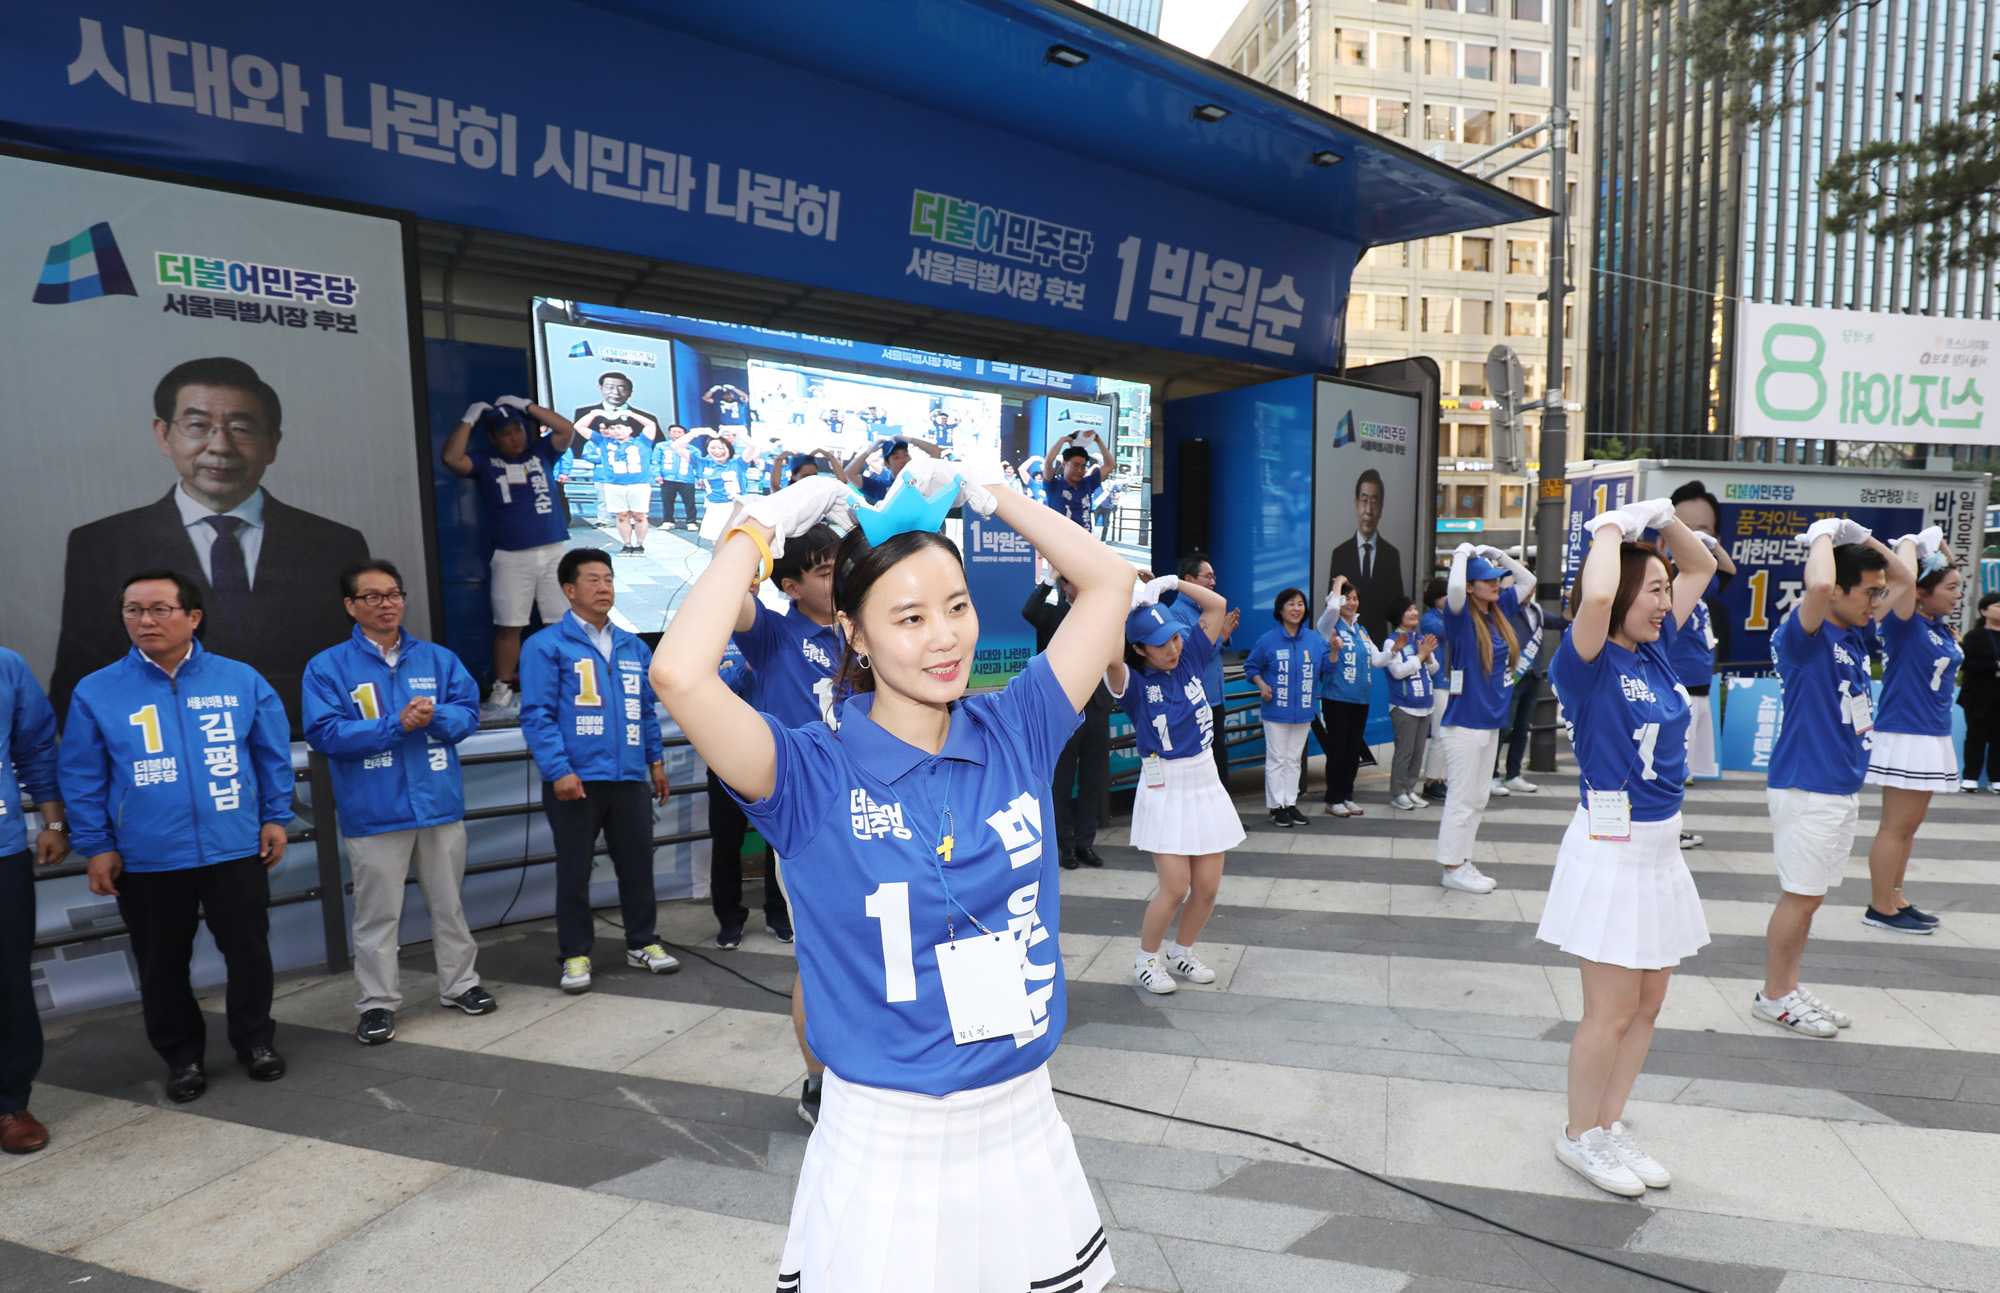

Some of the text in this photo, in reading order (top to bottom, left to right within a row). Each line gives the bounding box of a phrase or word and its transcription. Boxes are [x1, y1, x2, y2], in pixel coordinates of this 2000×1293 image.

[67, 17, 840, 241] 시대와 나란히 시민과 나란히
[909, 188, 1094, 275] 더불어민주당
[155, 251, 359, 307] 더불어민주당
[906, 248, 1086, 310] 서울특별시장 후보
[1113, 235, 1305, 356] 1 박원순
[163, 293, 358, 334] 서울특별시장 후보
[1360, 421, 1407, 443] 더불어민주당
[1725, 483, 1795, 500] 더불어민주당
[1860, 488, 1904, 504] 강남구청장
[970, 521, 1030, 553] 1 박원순
[1737, 509, 1808, 536] 품격있는
[1150, 608, 1164, 625] 1
[1744, 569, 1769, 631] 1
[973, 647, 1030, 661] 시대와 나란히
[973, 661, 1002, 675] 시민과
[1304, 650, 1311, 663] 1
[574, 658, 602, 706] 1
[1277, 660, 1289, 700] 시의원
[1930, 656, 1950, 691] 1
[187, 695, 239, 710] 서울시의원 후보
[350, 682, 381, 720] 1
[813, 677, 838, 731] 1
[129, 704, 164, 754] 1
[576, 715, 603, 725] 더불어
[576, 725, 604, 735] 민주당
[1152, 713, 1174, 751] 1
[133, 757, 177, 774] 더불어
[199, 711, 242, 811] 김평남
[363, 756, 393, 769] 민주당
[1632, 723, 1660, 780] 1
[134, 771, 178, 787] 민주당
[865, 881, 917, 1003] 1
